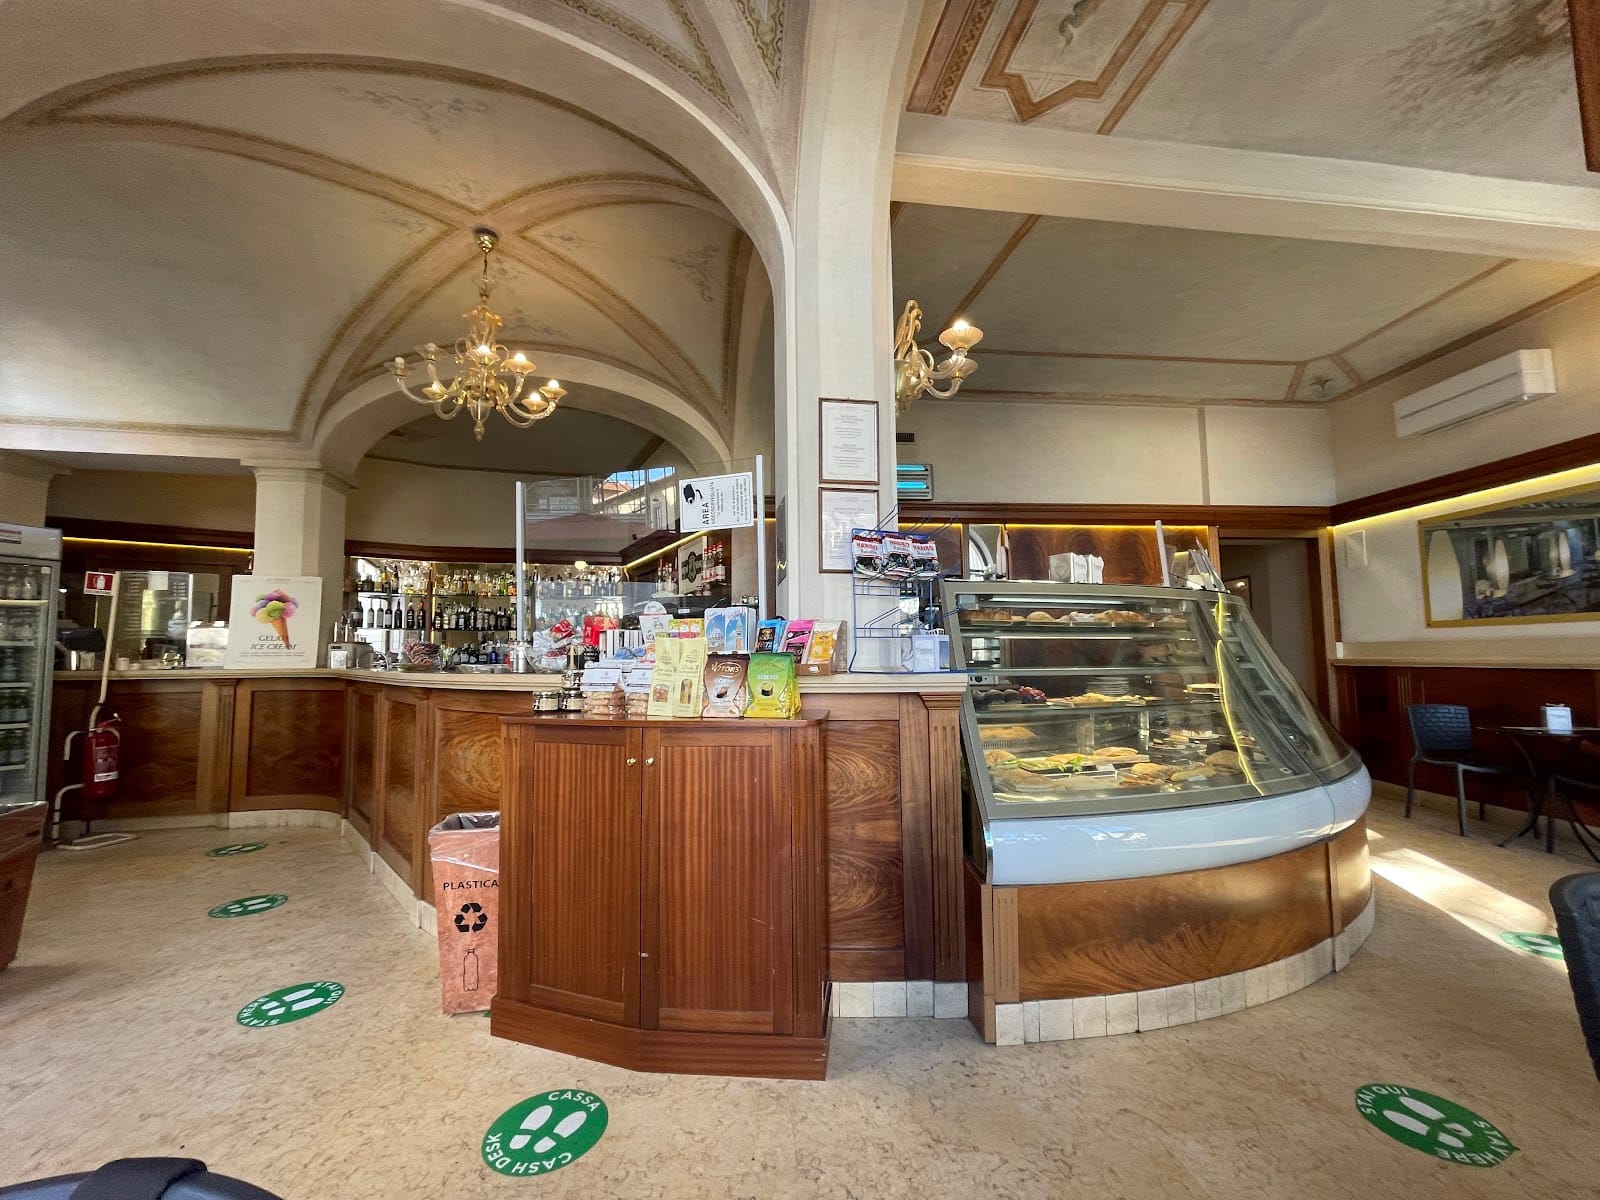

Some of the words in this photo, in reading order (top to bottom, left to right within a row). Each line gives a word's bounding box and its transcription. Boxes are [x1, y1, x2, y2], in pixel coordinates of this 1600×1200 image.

[702, 502, 710, 525] AREA
[856, 541, 878, 551] HARIBO
[443, 879, 499, 890] PLASTICA
[547, 1090, 601, 1112] CASSA
[1356, 1089, 1377, 1116] STAI
[1372, 1085, 1410, 1096] QUI
[1472, 1120, 1510, 1157] STAY
[485, 1132, 512, 1169] DESK
[511, 1152, 572, 1174] CASH
